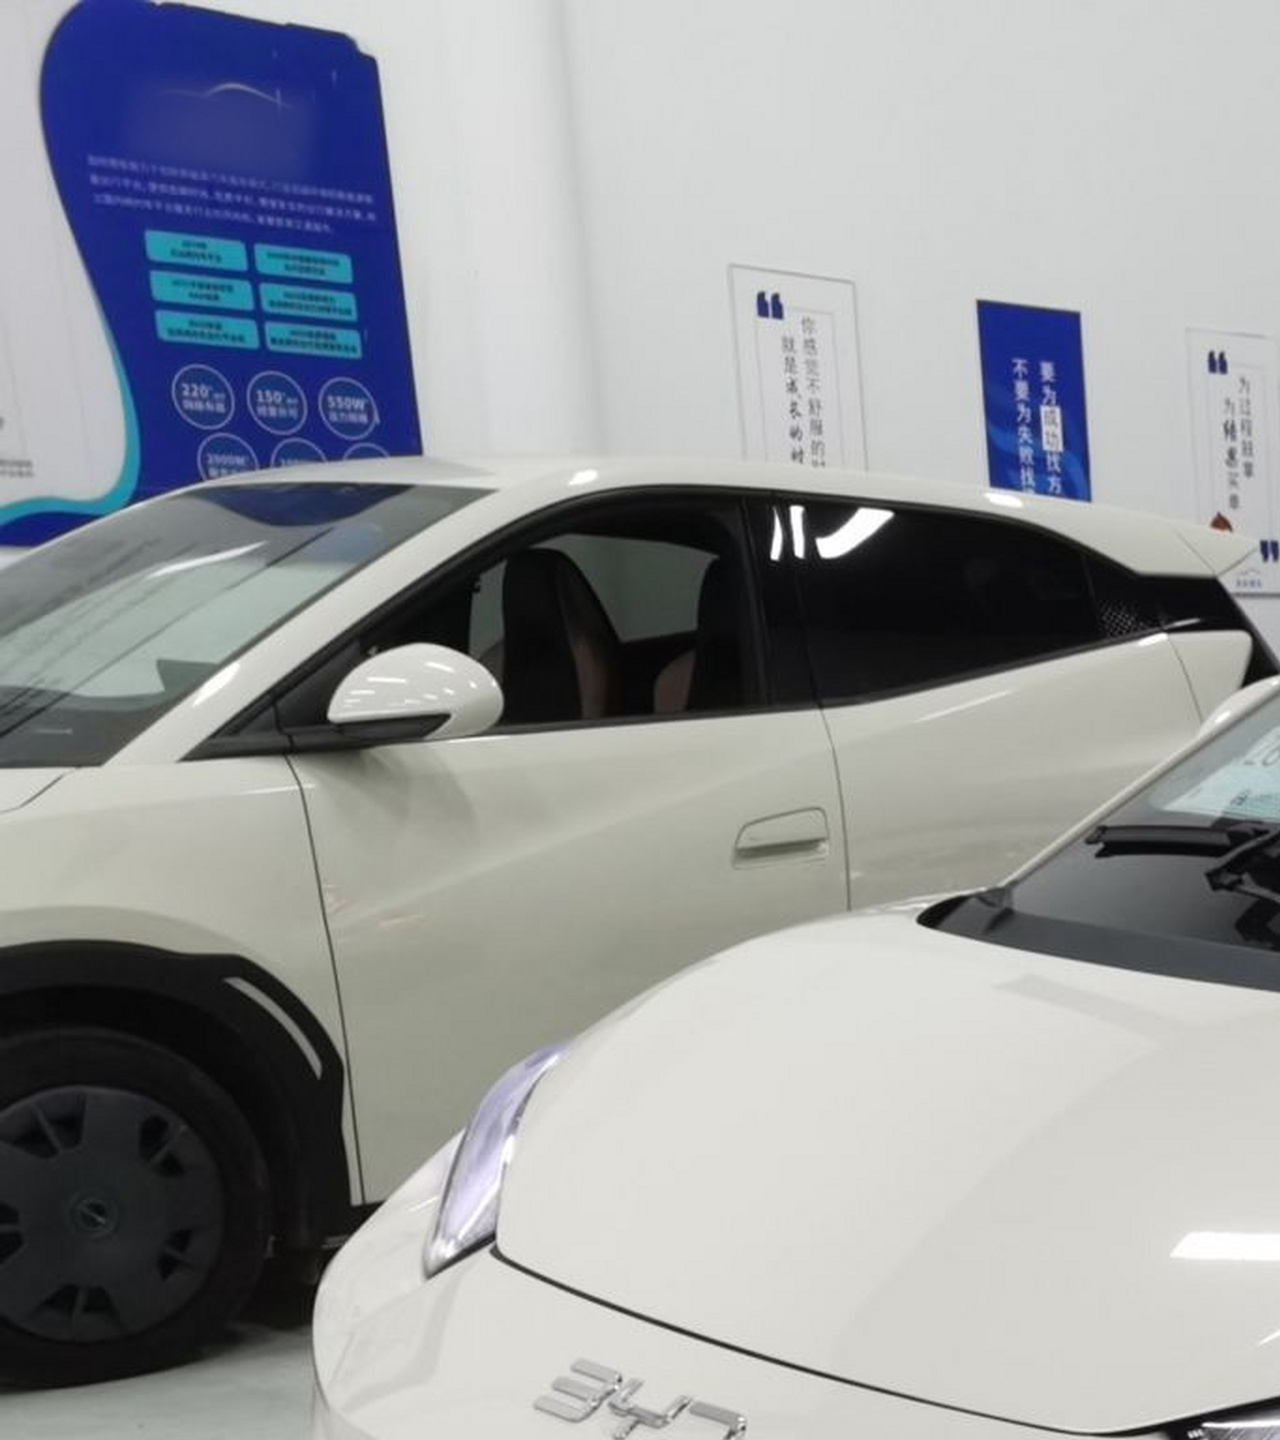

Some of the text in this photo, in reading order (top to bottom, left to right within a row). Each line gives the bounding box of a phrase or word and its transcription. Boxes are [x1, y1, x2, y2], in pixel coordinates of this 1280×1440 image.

[1011, 358, 1036, 494] 不要为失败找
